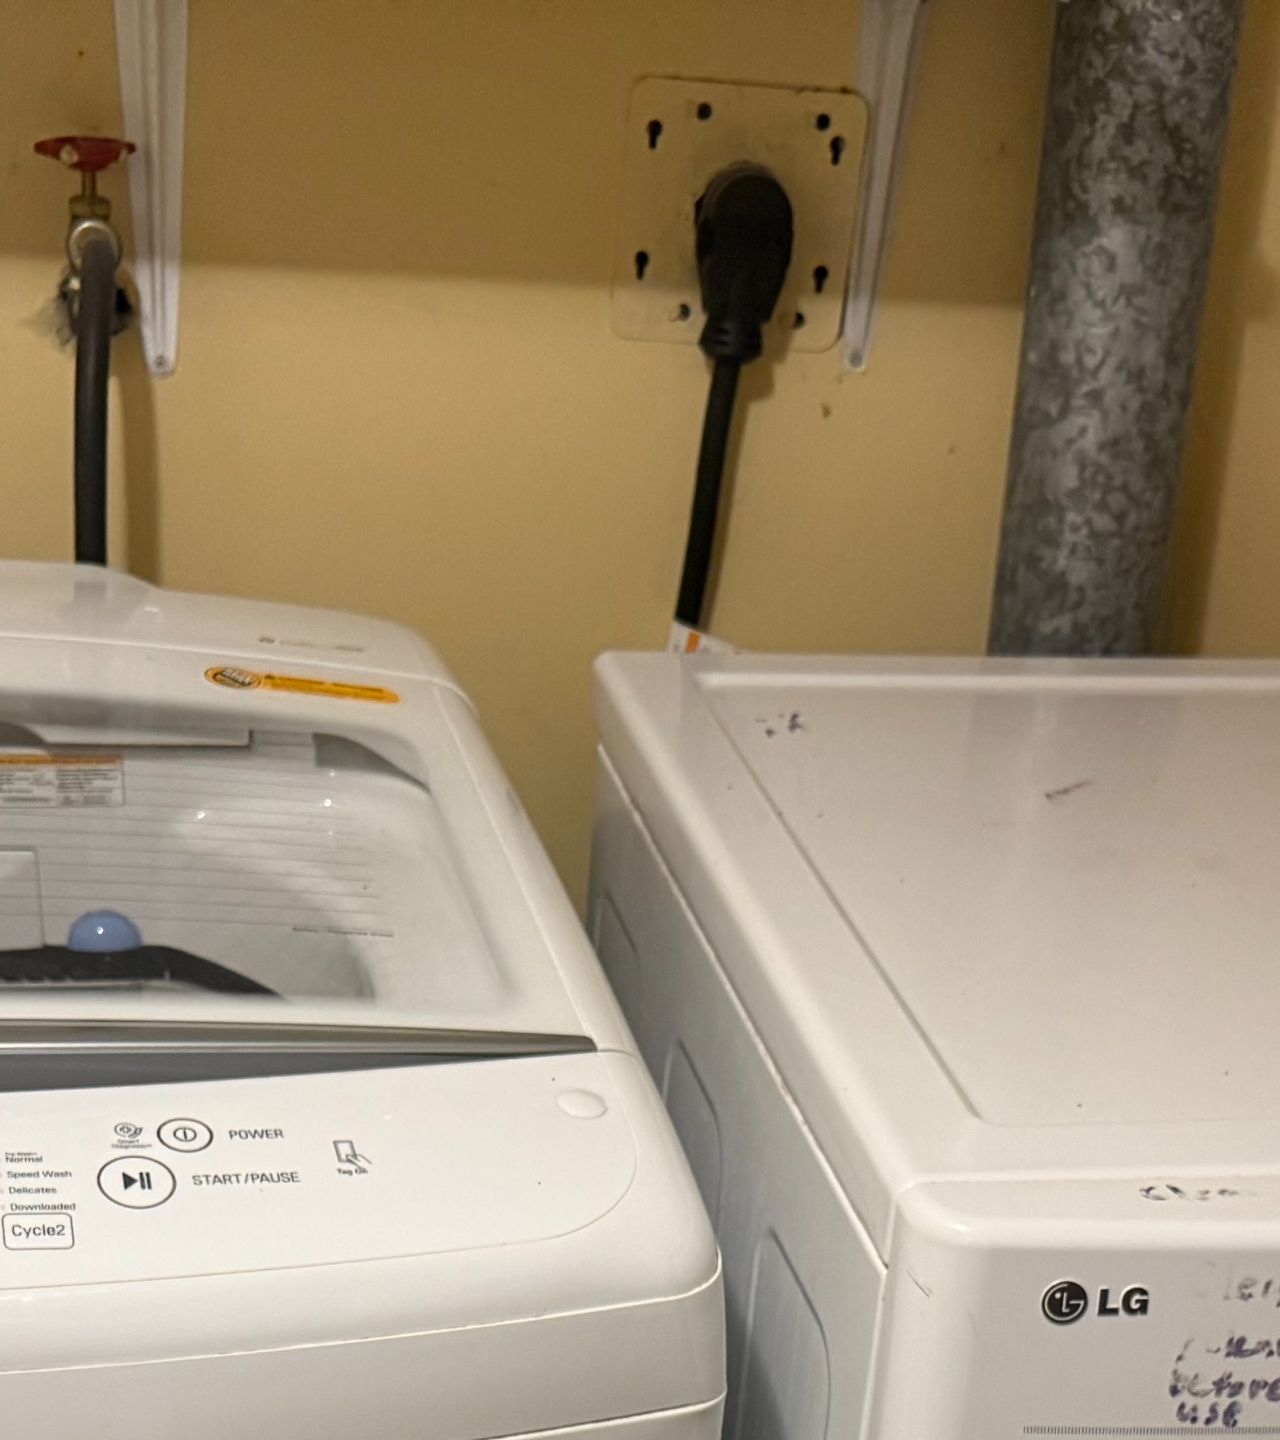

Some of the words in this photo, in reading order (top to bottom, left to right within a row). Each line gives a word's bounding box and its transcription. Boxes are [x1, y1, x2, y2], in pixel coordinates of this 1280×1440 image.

[228, 1128, 285, 1140] POWER
[5, 1155, 43, 1163] Normal
[7, 1170, 40, 1179] Speed
[42, 1170, 73, 1178] Wash
[8, 1186, 57, 1194] Delicates
[10, 1203, 77, 1211] Downloaded
[11, 1224, 66, 1239] Cycle2
[1096, 1286, 1150, 1317] LG
